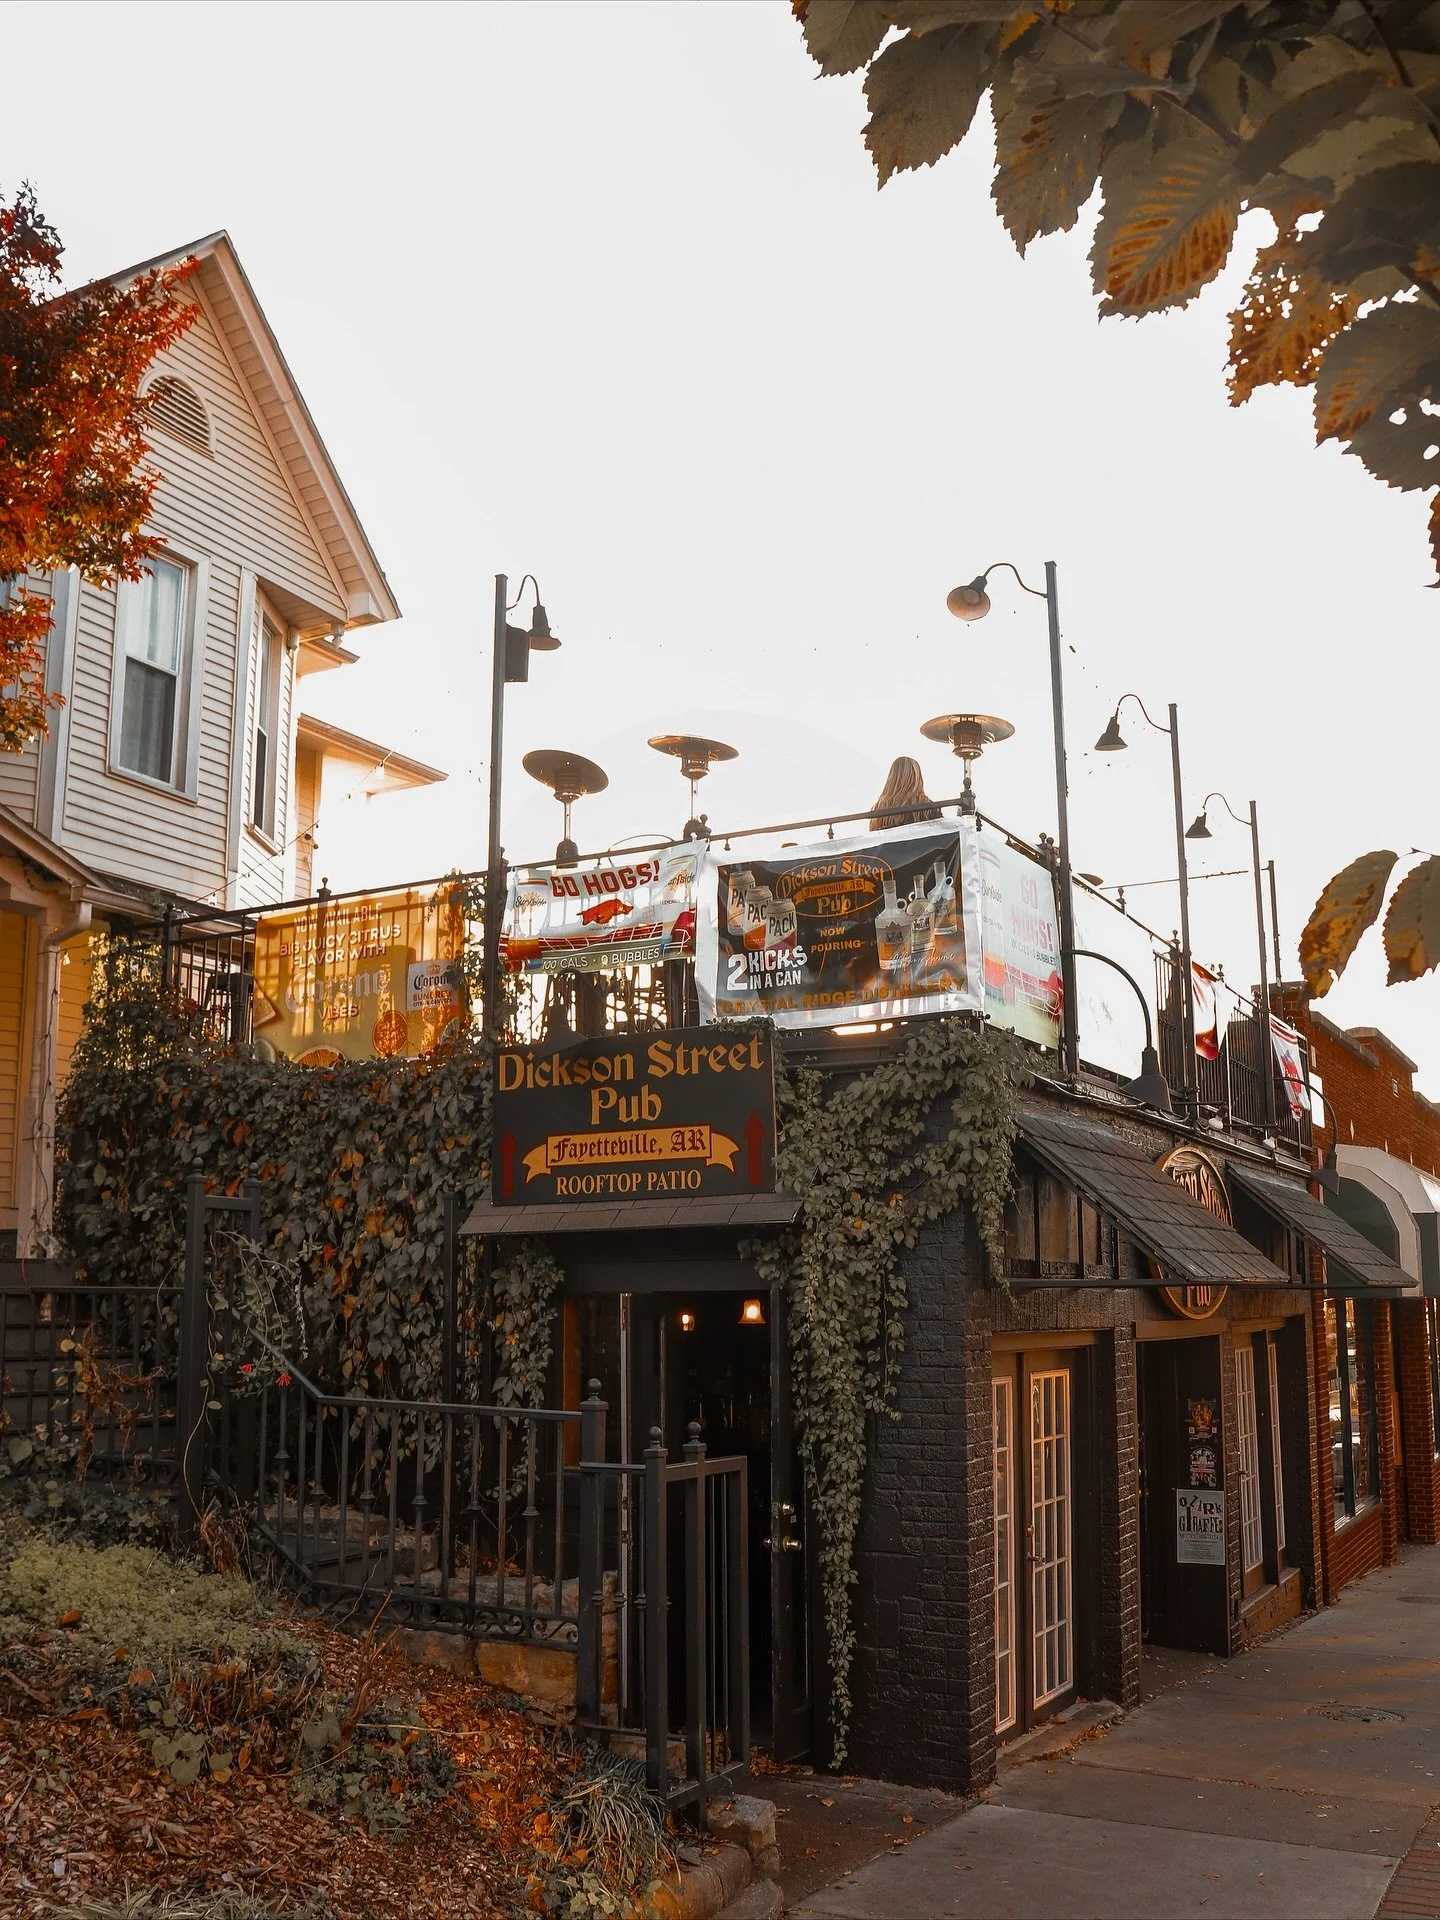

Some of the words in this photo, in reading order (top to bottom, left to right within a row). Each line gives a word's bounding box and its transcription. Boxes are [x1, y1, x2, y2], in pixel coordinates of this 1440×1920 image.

[551, 876, 580, 897] GO
[583, 859, 661, 895] HOGS!
[781, 864, 837, 898] Dickson
[841, 859, 885, 881] Street
[848, 879, 864, 890] AR
[747, 902, 768, 923] PAC
[817, 894, 852, 914] Pub
[294, 913, 319, 933] NOW
[323, 902, 383, 928] AVAILABLE
[768, 912, 796, 937] PACK
[280, 941, 300, 957] BIG
[303, 933, 345, 951] JUICY
[350, 923, 401, 945] CITRUS
[820, 926, 846, 938] NOW
[349, 941, 387, 960] WITH
[811, 940, 861, 953] POURING
[542, 960, 557, 970] 100
[559, 956, 588, 969] CALS
[612, 948, 660, 964] BUBBLES
[727, 953, 748, 991] 2
[748, 945, 808, 974] KICKS
[749, 974, 762, 990] IN
[764, 973, 773, 988] A
[775, 970, 802, 987] CAN
[721, 995, 798, 1013] CRYSTAL
[803, 990, 857, 1006] RIDGE
[499, 1051, 634, 1091] Dickson
[647, 1035, 764, 1078] Street
[590, 1084, 663, 1125] Pub
[551, 1134, 663, 1163] Fayetteville,
[670, 1126, 707, 1152] AR
[555, 1172, 641, 1195] ROOFTOP
[647, 1169, 702, 1192] PATIO
[1179, 1494, 1223, 1515] OZARK
